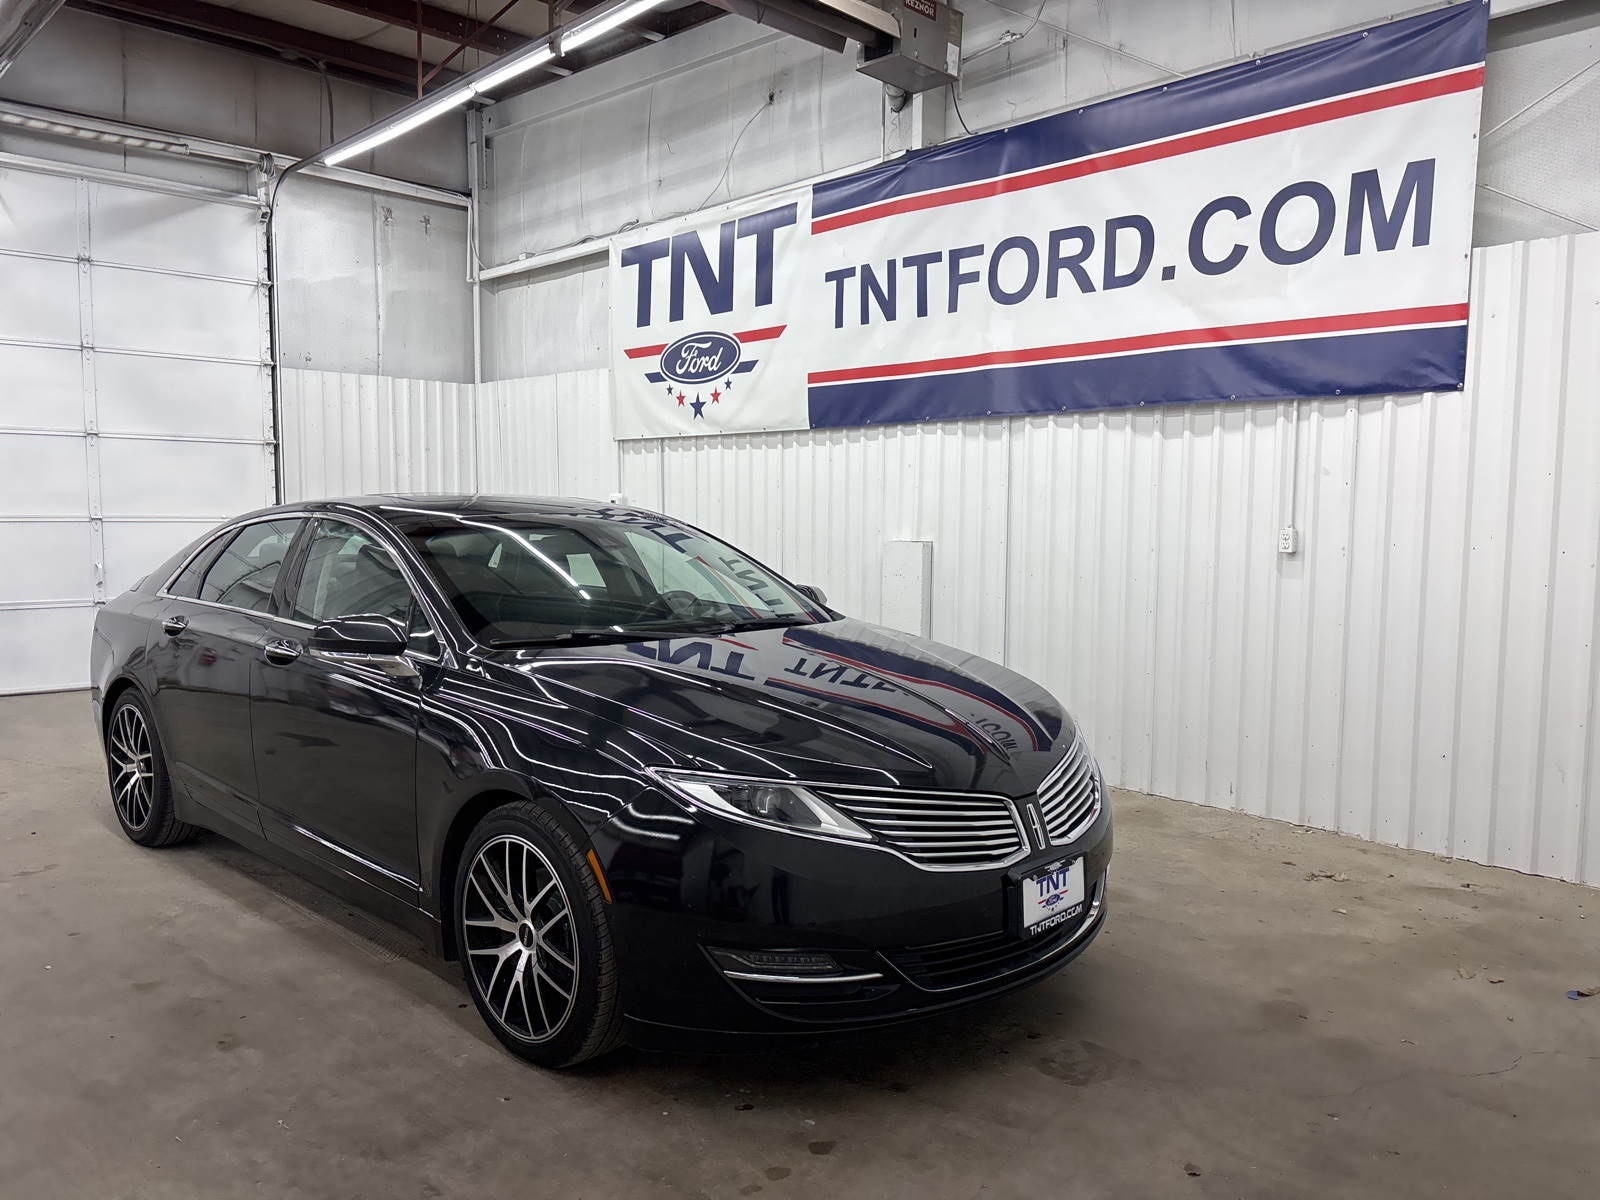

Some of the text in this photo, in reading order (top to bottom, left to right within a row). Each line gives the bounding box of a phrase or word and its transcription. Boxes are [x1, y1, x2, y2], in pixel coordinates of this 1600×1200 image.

[824, 157, 1436, 329] TNTFORD.COM
[621, 202, 798, 328] TNT
[675, 341, 724, 375] Ford
[1036, 867, 1069, 897] TNT
[1030, 904, 1082, 935] TNTFORD.COM
